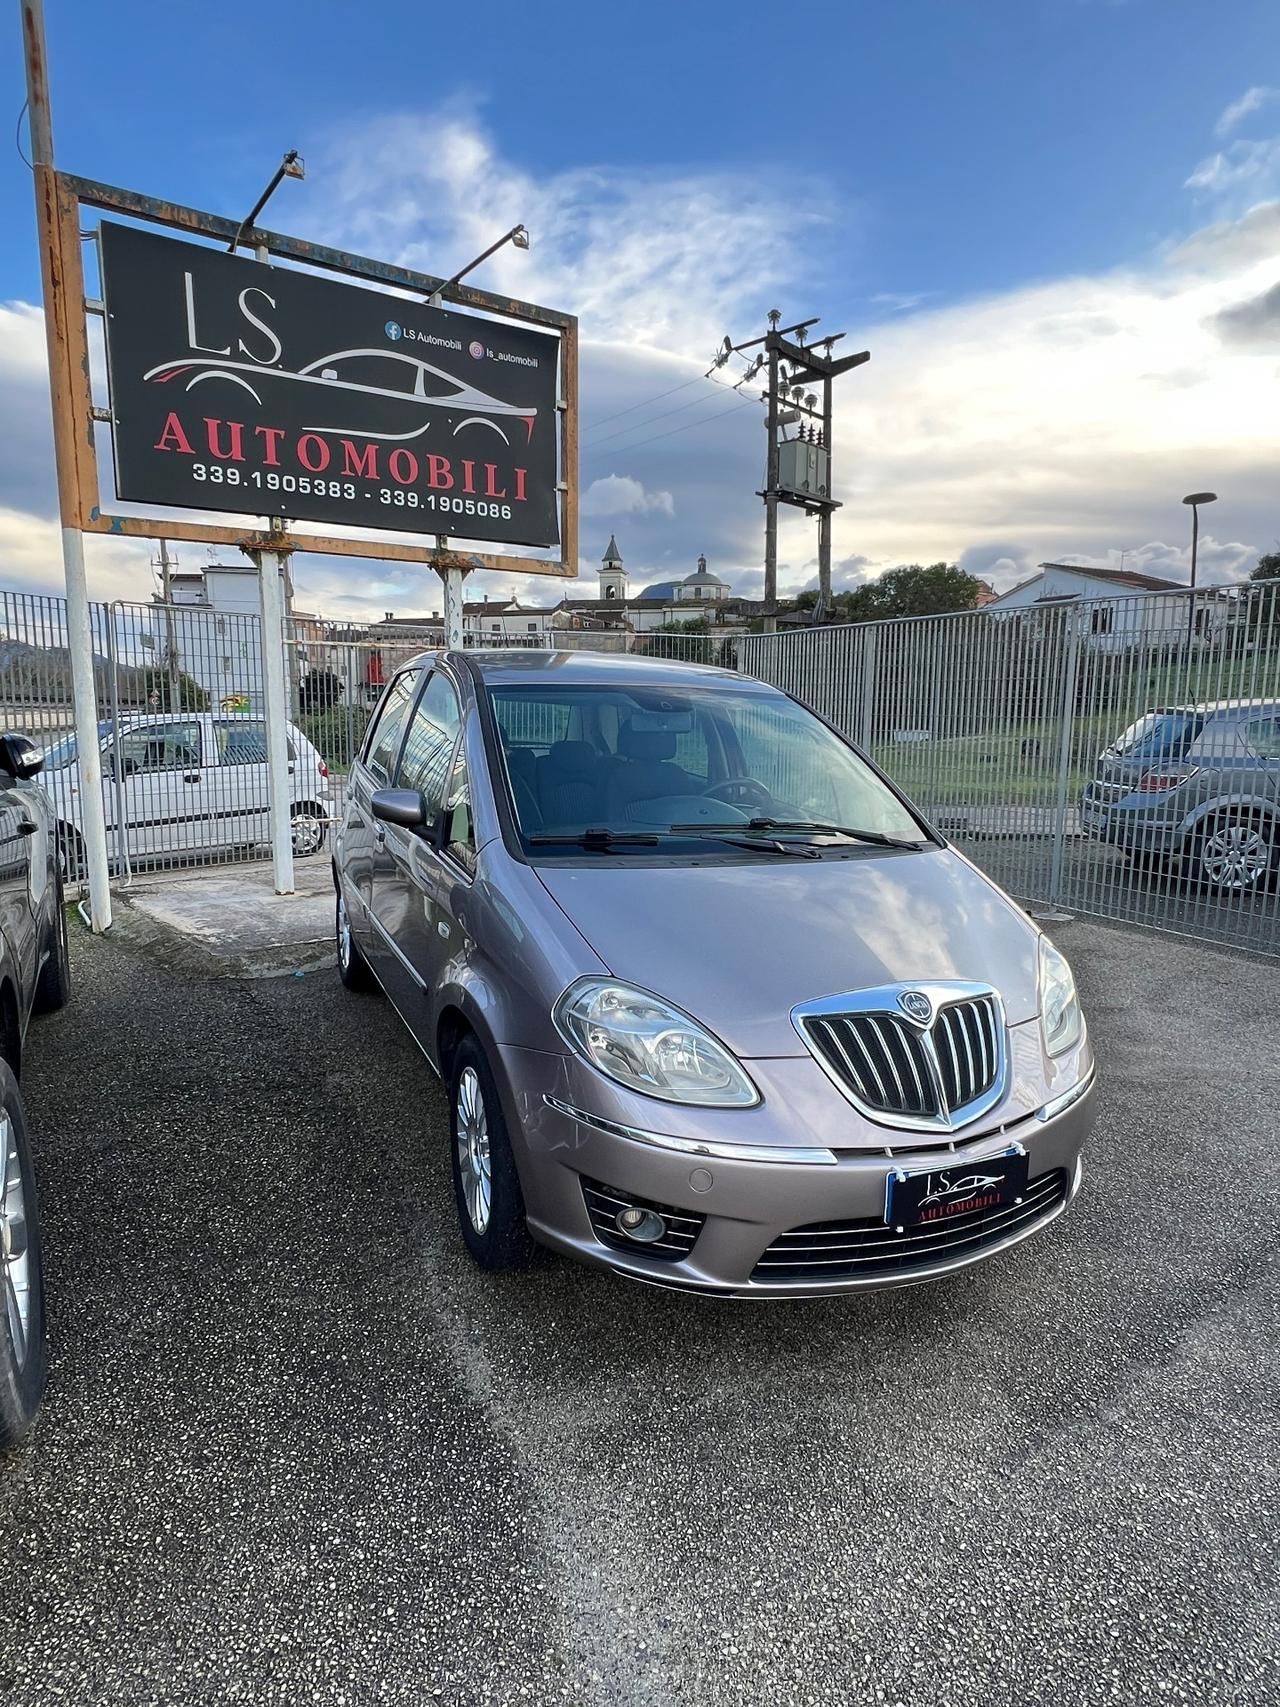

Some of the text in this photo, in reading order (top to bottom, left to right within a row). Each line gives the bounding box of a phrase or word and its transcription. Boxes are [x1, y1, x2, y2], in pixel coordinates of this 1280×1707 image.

[403, 328, 462, 350] LS Automobili
[154, 412, 527, 500] AUTOMOBILI
[193, 463, 356, 500] 339.1905383
[380, 488, 512, 520] 339.1905086
[918, 1192, 1002, 1222] AUTOMOBILI
